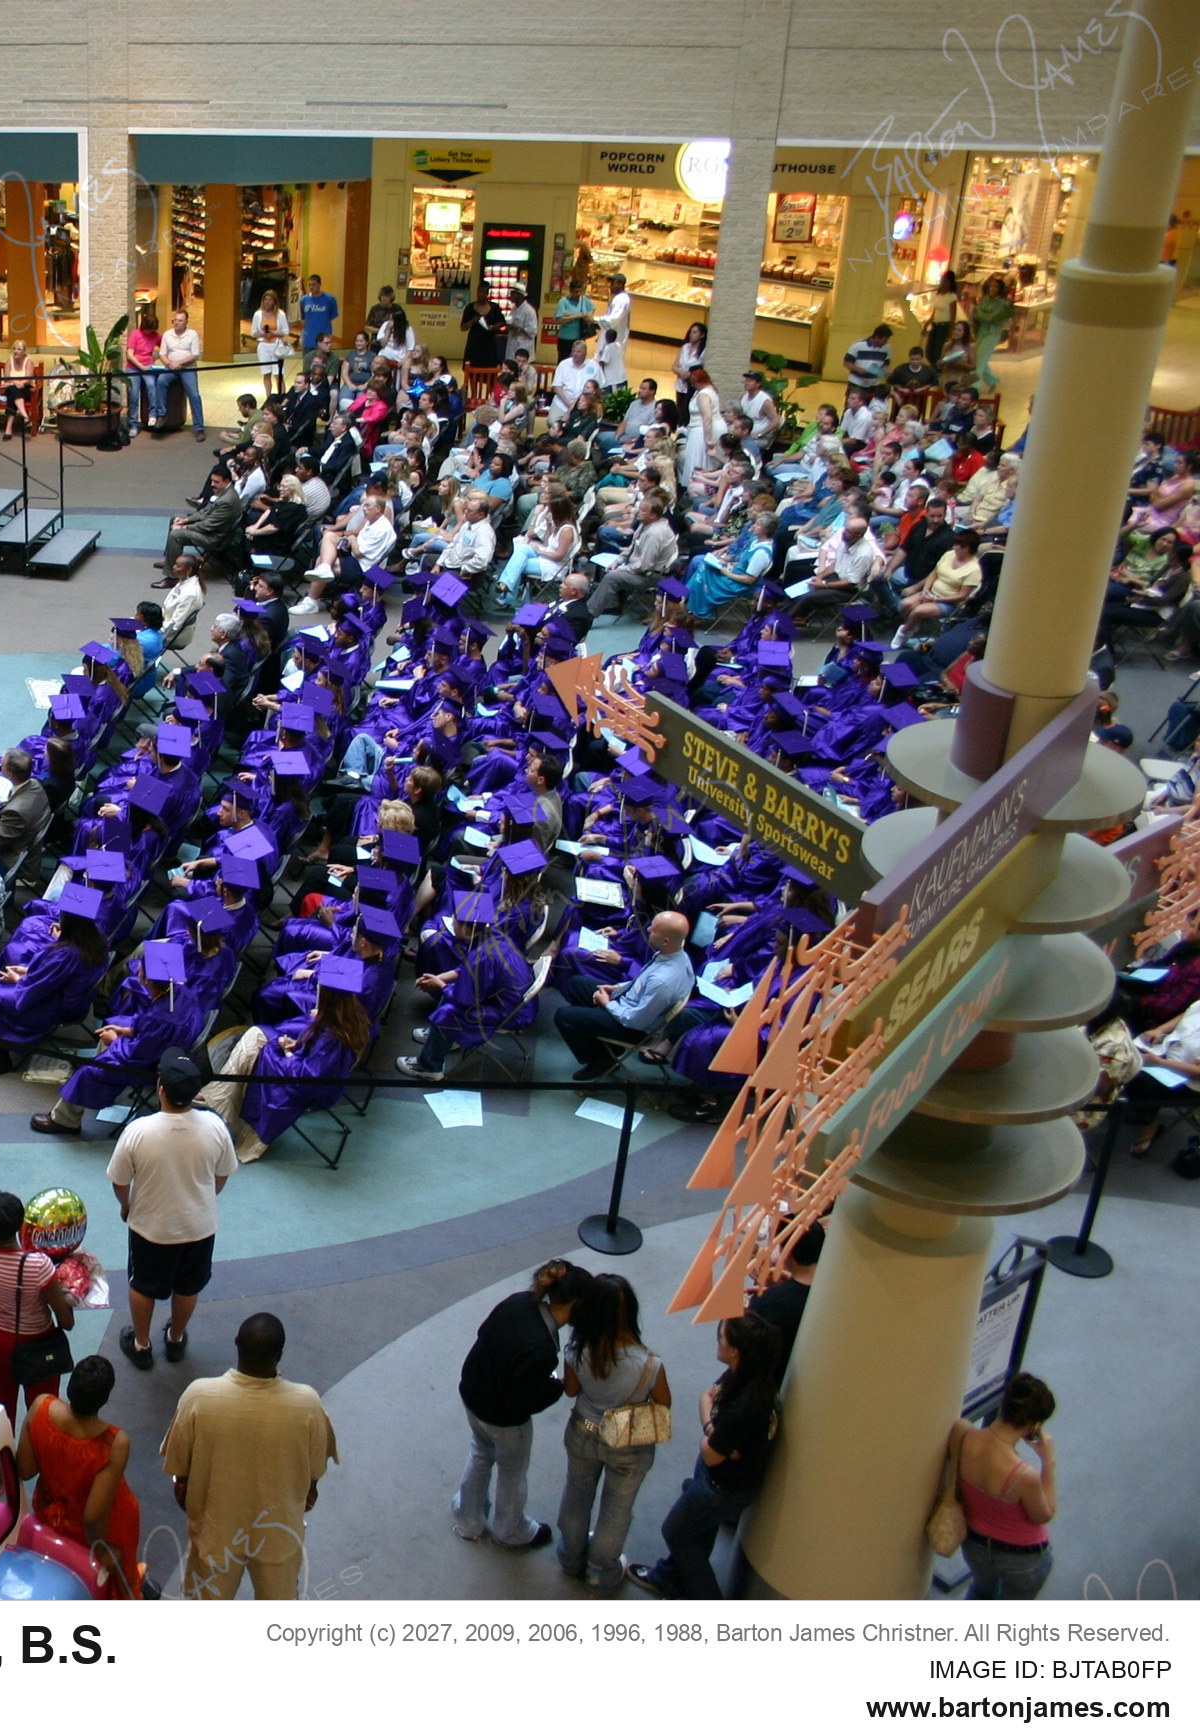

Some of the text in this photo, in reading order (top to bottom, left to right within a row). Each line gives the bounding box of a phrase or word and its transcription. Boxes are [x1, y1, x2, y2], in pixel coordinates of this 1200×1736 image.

[600, 151, 665, 163] POPCORN
[608, 163, 655, 174] WORLD
[772, 163, 836, 174] UTHOUSE
[682, 731, 850, 863] STEVE & BARRY'S
[688, 766, 835, 881] University Sportswear
[909, 779, 1028, 918] KAUFMANN'S
[966, 819, 1019, 883] GALLERIES
[883, 907, 985, 1042] SEARS
[861, 1033, 936, 1148] Food
[978, 1303, 1006, 1324] ATTER
